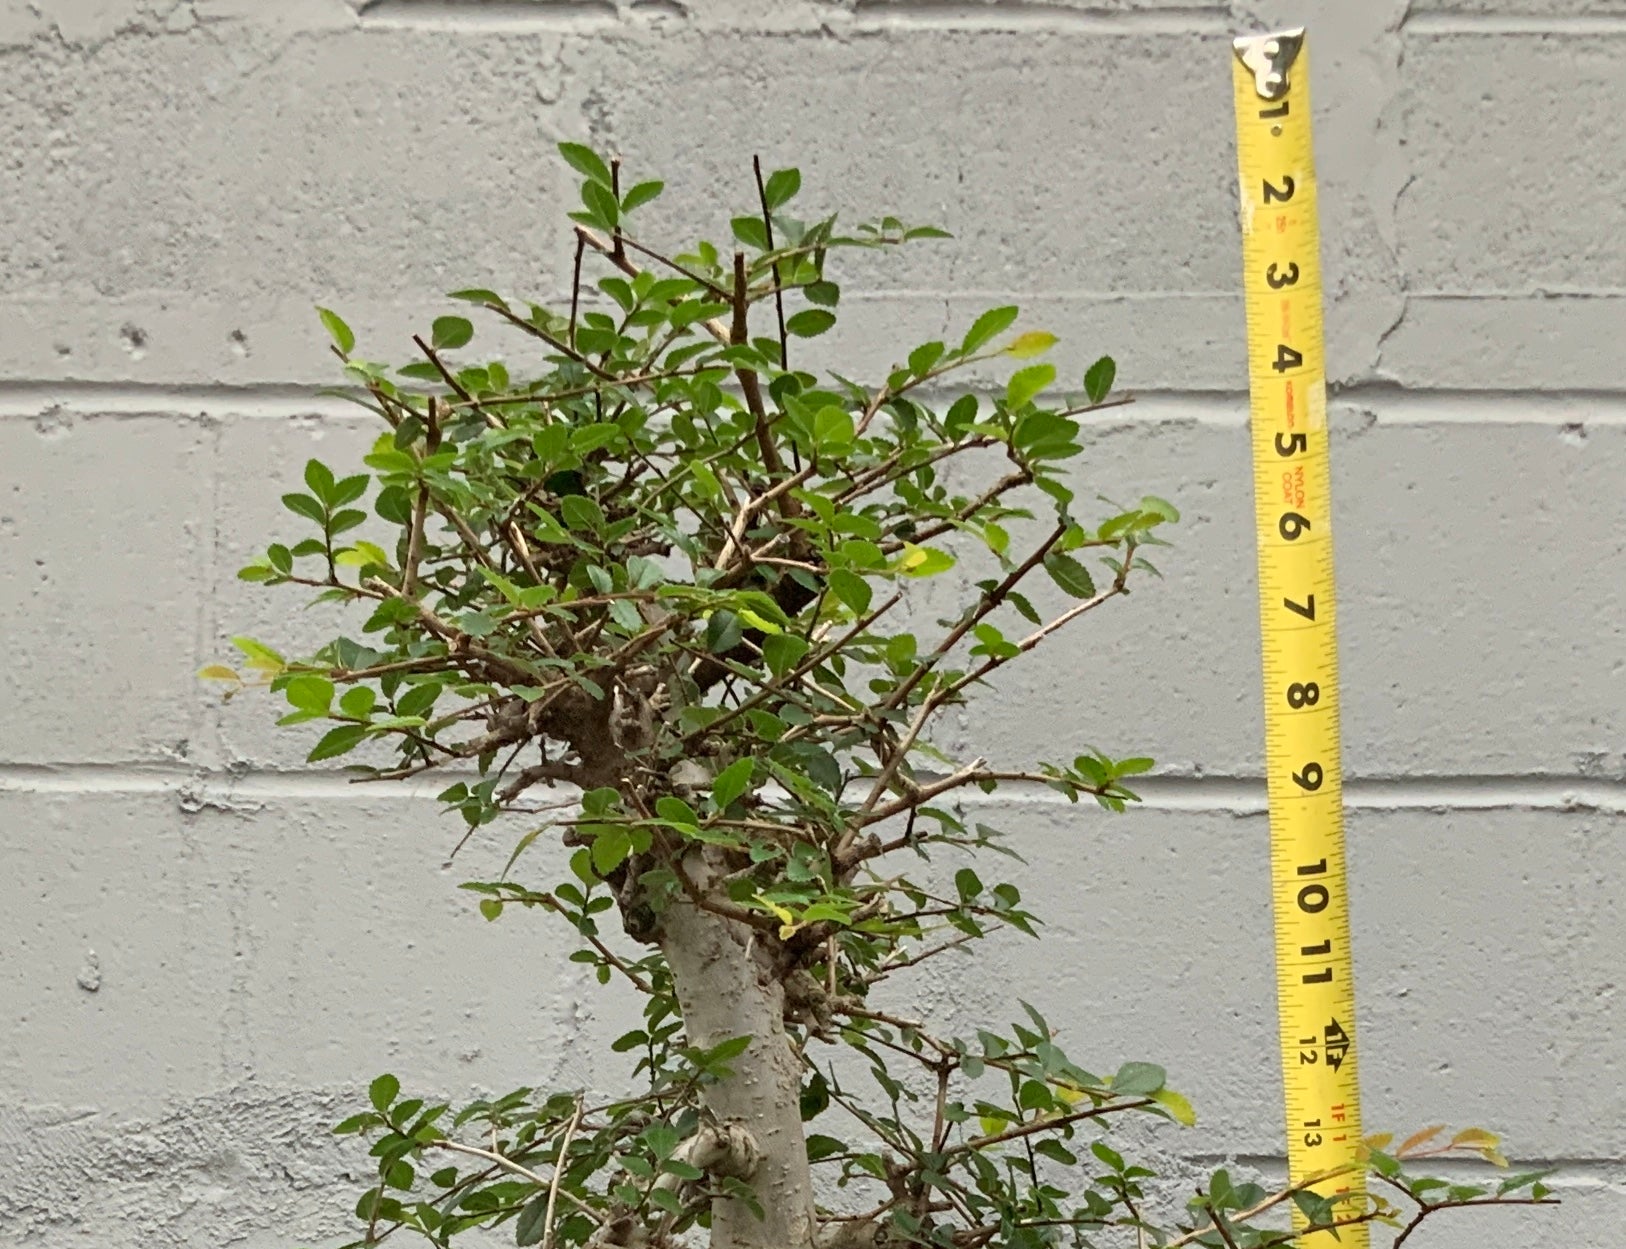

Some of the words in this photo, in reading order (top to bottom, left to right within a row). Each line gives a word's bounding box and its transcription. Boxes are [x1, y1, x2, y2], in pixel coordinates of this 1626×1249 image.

[1259, 101, 1290, 119] 1
[1263, 175, 1295, 204] 2
[1266, 262, 1299, 289] 3
[1272, 344, 1303, 373] 4
[1275, 432, 1307, 457] 5
[1282, 471, 1293, 504] COAT
[1294, 465, 1305, 509] NYLON
[1279, 512, 1311, 541] 6
[1284, 594, 1315, 621] 7
[1287, 682, 1320, 709] 8
[1292, 762, 1323, 791] 9
[1297, 858, 1329, 913] 10
[1301, 939, 1333, 984] 11
[1299, 1036, 1318, 1065] 12
[1303, 1119, 1322, 1147] 13
